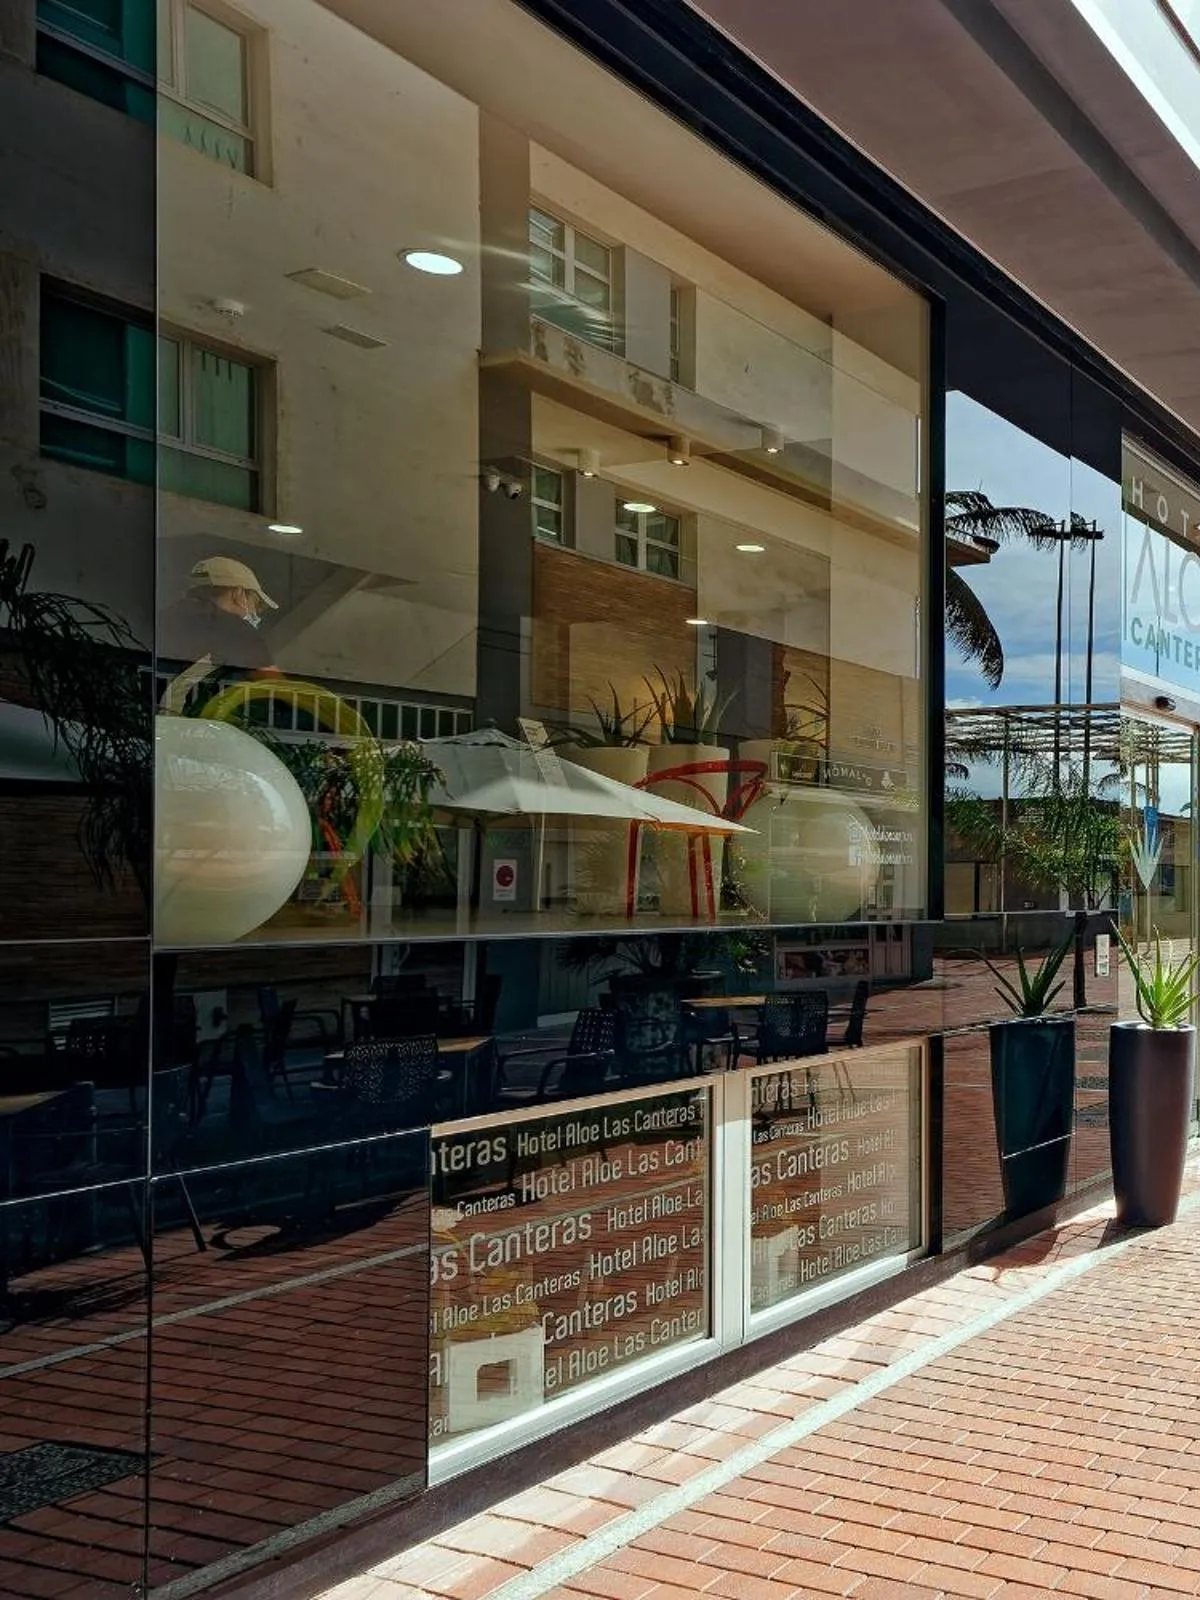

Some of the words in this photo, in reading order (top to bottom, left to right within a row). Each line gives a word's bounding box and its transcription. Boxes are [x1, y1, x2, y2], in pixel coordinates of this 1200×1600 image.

[517, 1126, 561, 1158] Hotel
[565, 1121, 600, 1147] Aloe
[604, 1116, 630, 1139] Las
[634, 1104, 696, 1133] Canteras
[807, 1100, 840, 1131] Hotel
[457, 1192, 516, 1218] Canteras
[522, 1162, 575, 1203] Hotel
[582, 1157, 622, 1188] Aloe
[628, 1149, 660, 1176] Las
[777, 1140, 850, 1181] Canteras
[763, 1204, 784, 1221] Aoe
[785, 1195, 802, 1215] Las
[803, 1184, 844, 1209] Canteras
[847, 1163, 877, 1194] Hotel
[469, 1213, 592, 1273] Canteras
[607, 1198, 648, 1234] Hotel
[652, 1193, 683, 1220] Aloe
[819, 1203, 877, 1241] Canteras
[443, 1304, 479, 1331] Aloe
[483, 1293, 512, 1317] Las
[516, 1269, 581, 1305] Canteras
[590, 1241, 637, 1281] Hotel
[642, 1234, 678, 1263] Aloe
[541, 1290, 638, 1346] Canteras
[645, 1273, 683, 1307] Hotel
[569, 1346, 609, 1380] Aloe
[615, 1332, 646, 1360] Las
